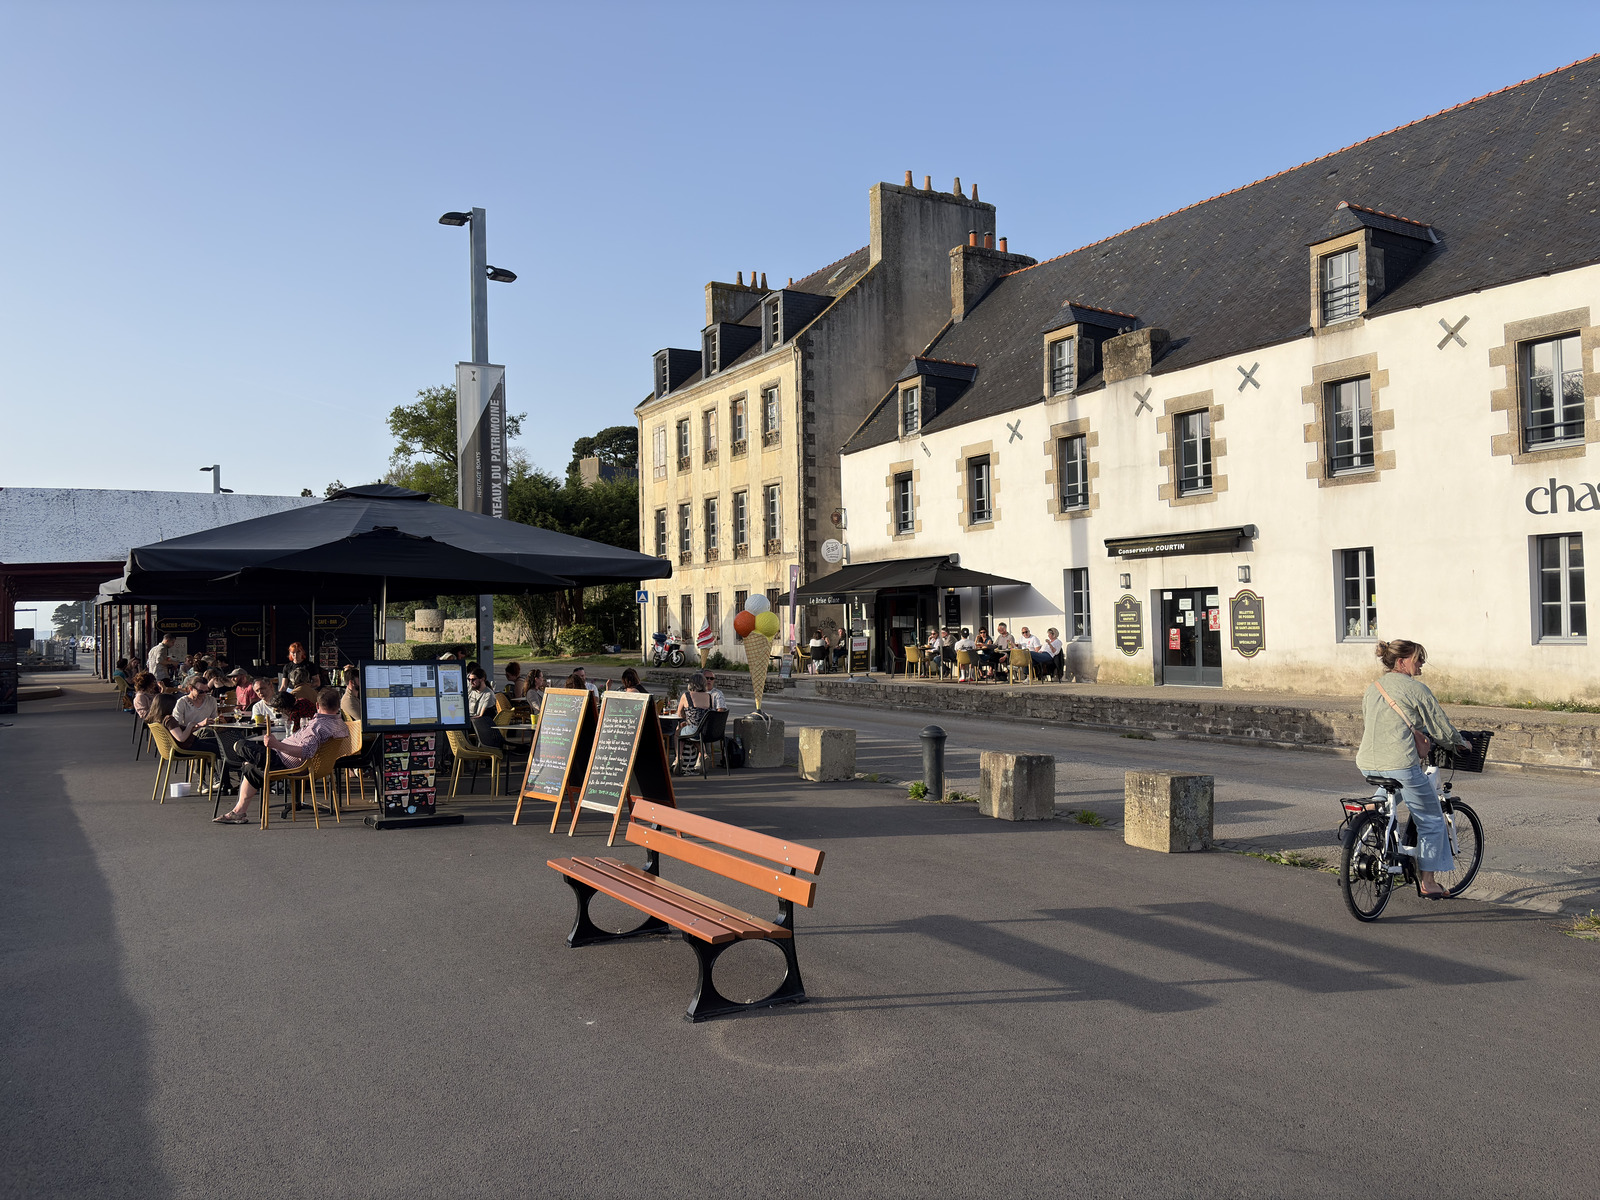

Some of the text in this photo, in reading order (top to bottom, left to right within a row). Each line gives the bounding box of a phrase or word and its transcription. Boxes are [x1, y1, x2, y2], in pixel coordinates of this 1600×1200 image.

[490, 399, 502, 462] PATRIMOINE
[491, 465, 502, 479] DU
[1525, 477, 1600, 515] cha
[1118, 543, 1185, 555] Conserverie COURTIN
